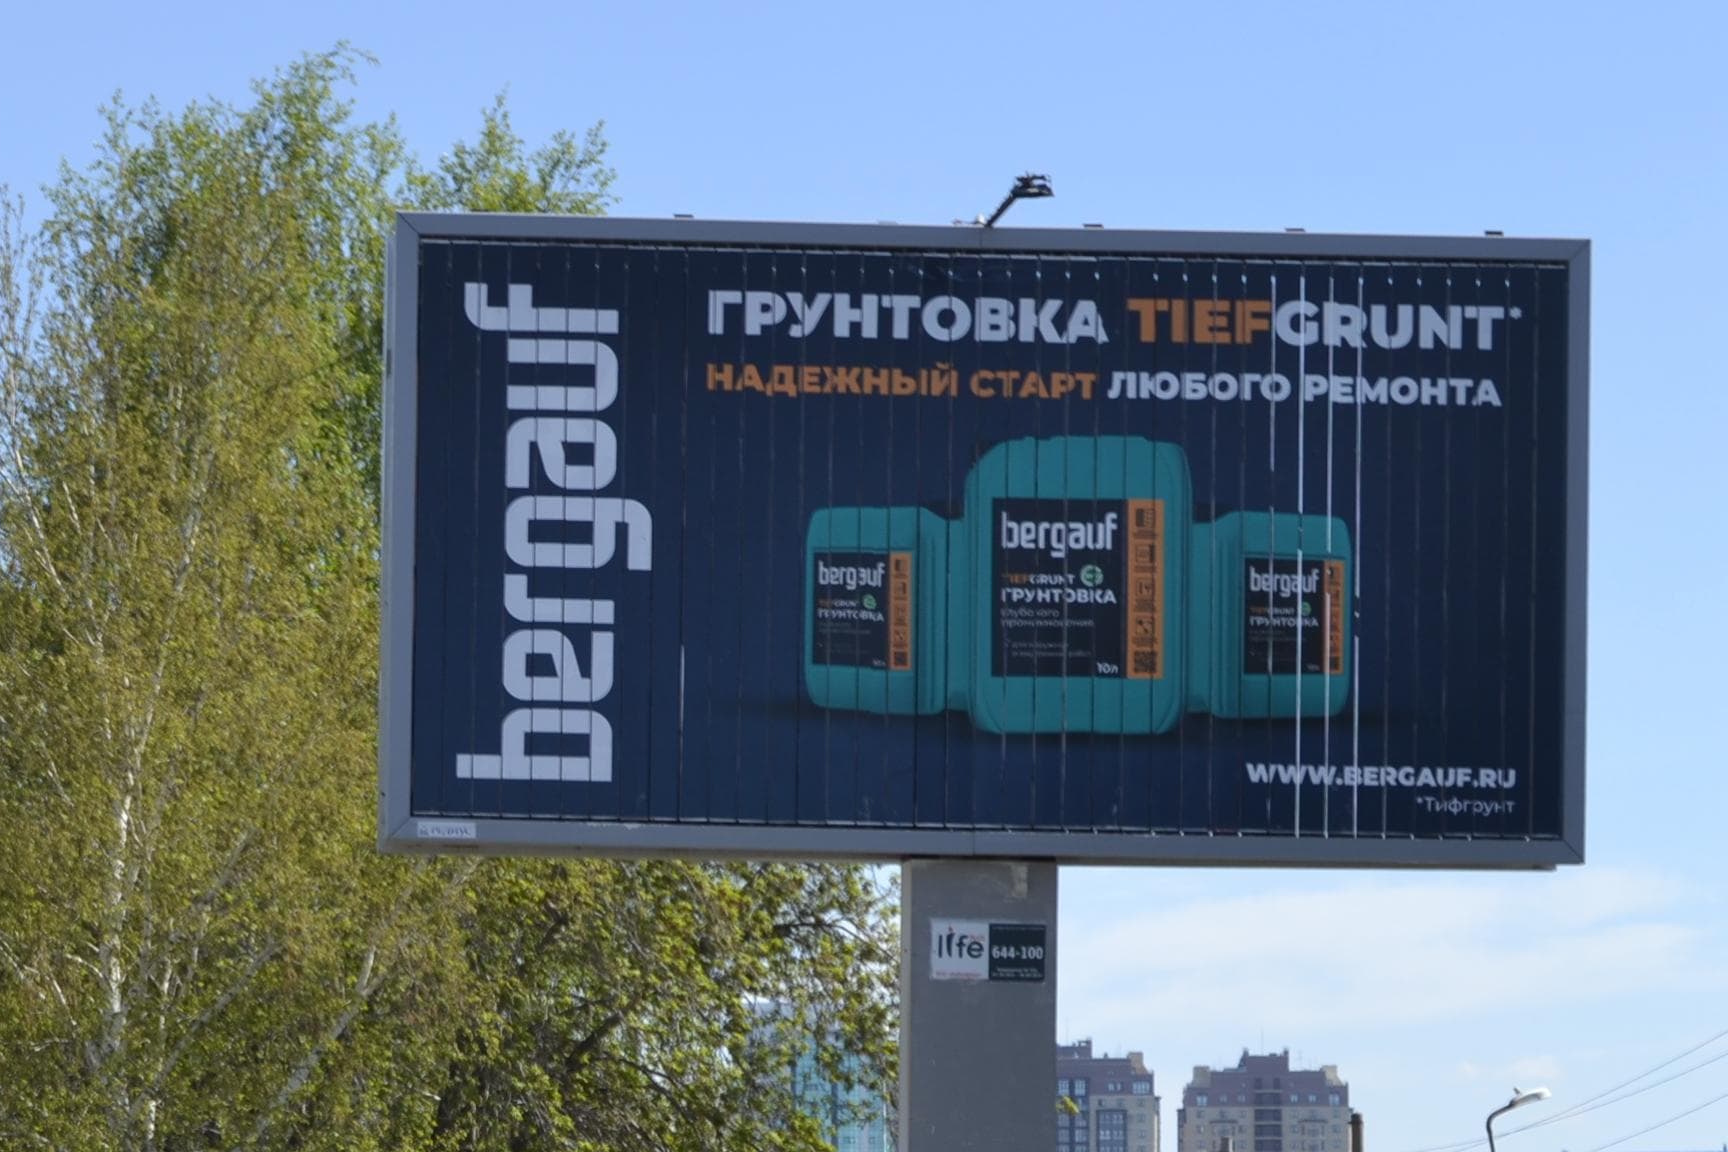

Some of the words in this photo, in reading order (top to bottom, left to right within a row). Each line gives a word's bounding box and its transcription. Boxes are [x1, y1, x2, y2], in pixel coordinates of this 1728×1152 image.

[708, 290, 1108, 344] ГРУНТОВКА
[706, 361, 958, 398] НАДЕЖНЫЙ
[970, 369, 1096, 399] СТАРТ
[1107, 371, 1291, 401] ЛЮБОГО
[1304, 373, 1502, 407] РЕМОНТА
[456, 282, 653, 783] bergauf
[1002, 511, 1118, 558] bergauf
[818, 560, 886, 590] bergauf
[1249, 566, 1319, 597] bergauf
[1002, 588, 1117, 604] ГРУНТОВКА
[1246, 763, 1516, 788] WWW.BERGAUF.RU
[992, 946, 1043, 959] 644-100
